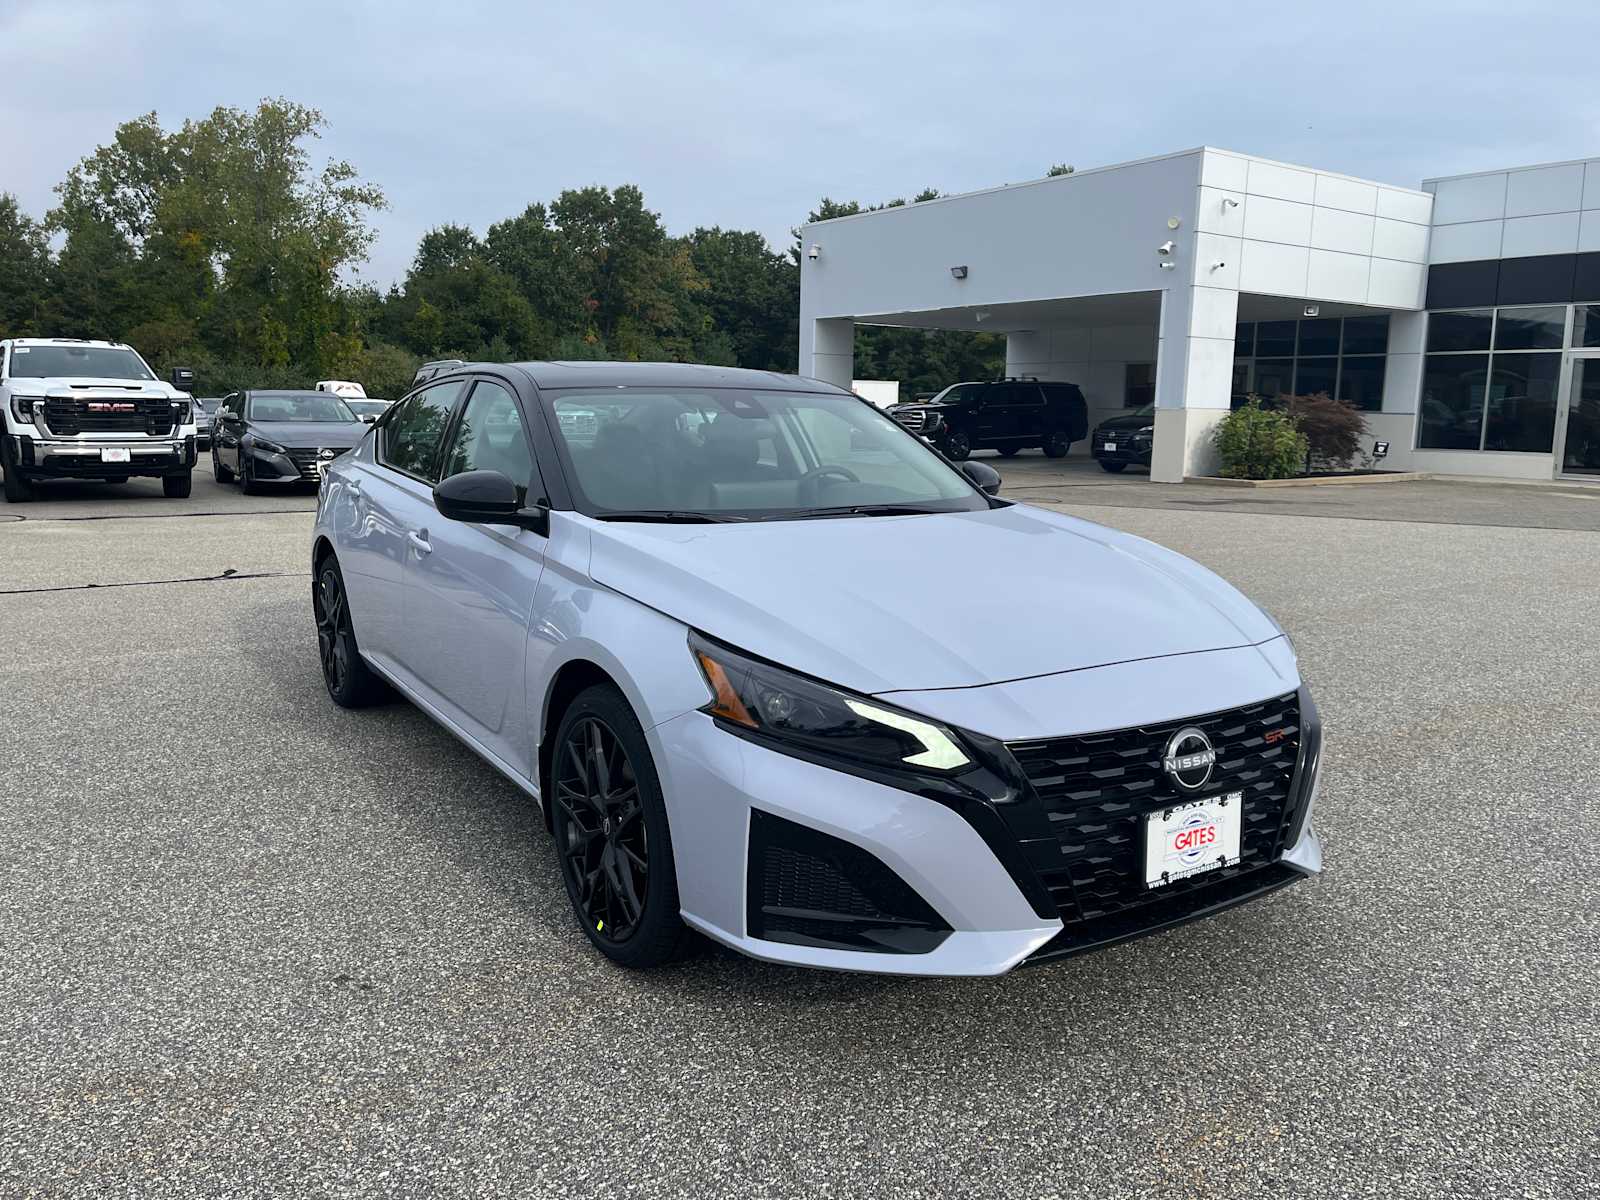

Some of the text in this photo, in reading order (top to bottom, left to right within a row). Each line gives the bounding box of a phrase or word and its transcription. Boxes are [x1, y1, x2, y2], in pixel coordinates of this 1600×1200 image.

[88, 402, 135, 412] GMC
[1264, 729, 1285, 744] SR
[1165, 750, 1216, 771] NISSAN
[1175, 827, 1215, 850] GATES
